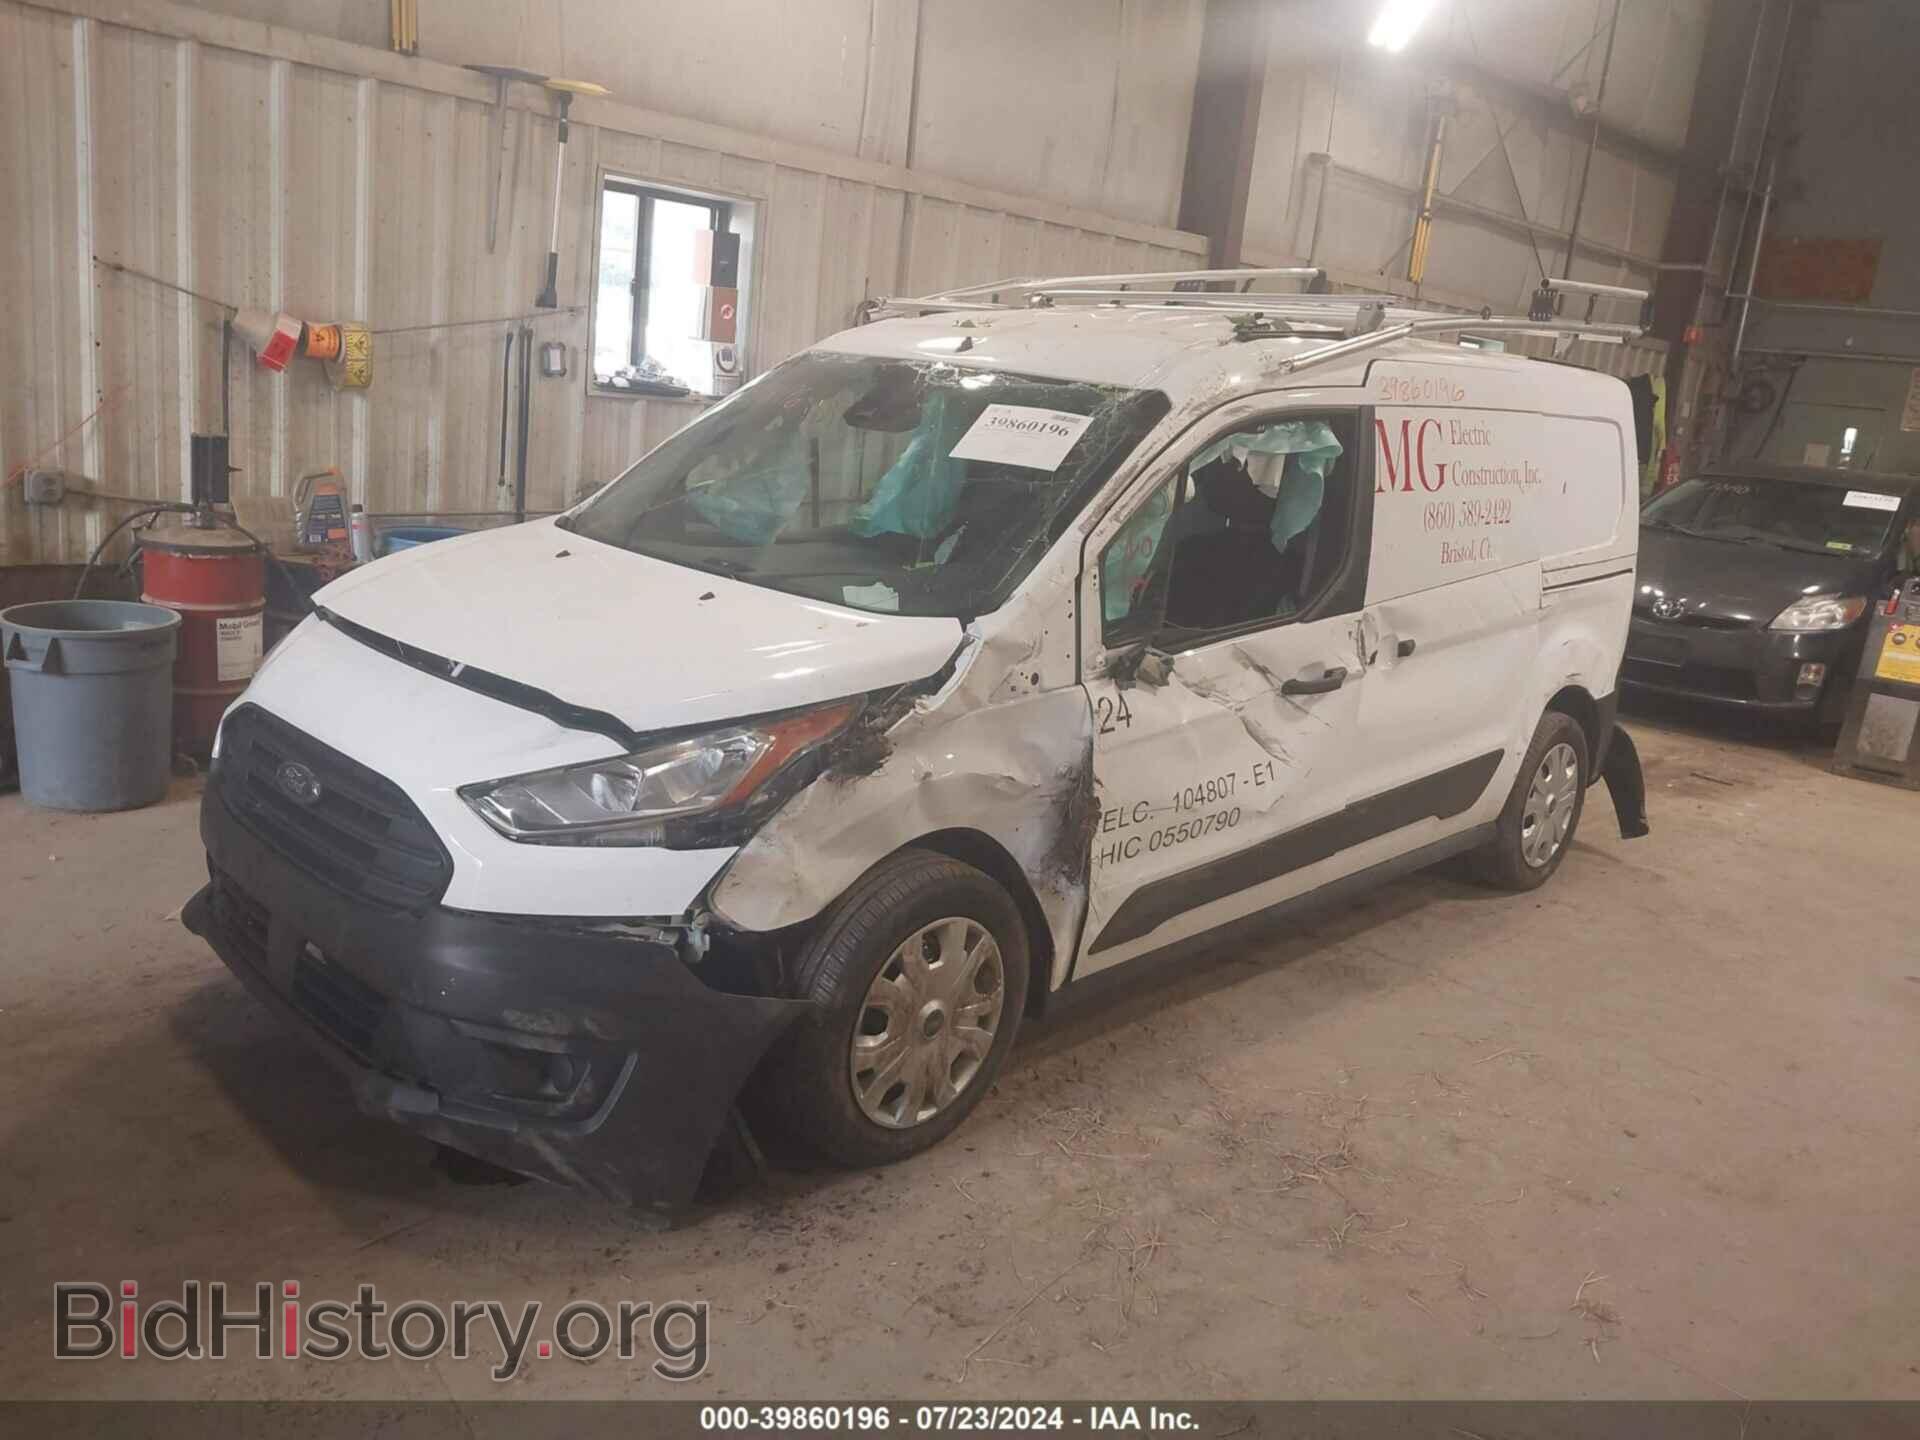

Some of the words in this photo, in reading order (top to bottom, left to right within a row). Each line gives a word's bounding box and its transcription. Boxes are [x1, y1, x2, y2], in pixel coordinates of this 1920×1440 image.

[984, 415, 1070, 438] 39860196
[1450, 418, 1492, 446] Electric
[1375, 418, 1447, 493] MG
[1452, 460, 1523, 494] Construction,
[1524, 459, 1542, 485] Inc.
[1423, 502, 1456, 534] (860)
[1458, 499, 1512, 528] 589-2422
[1440, 541, 1477, 565] Bristol,
[1098, 693, 1133, 735] 24
[1102, 800, 1154, 834] ELC.
[1172, 772, 1236, 813] 104807
[1252, 760, 1275, 787] E1
[1099, 836, 1143, 868] HIC
[1149, 807, 1241, 852] 0550790
